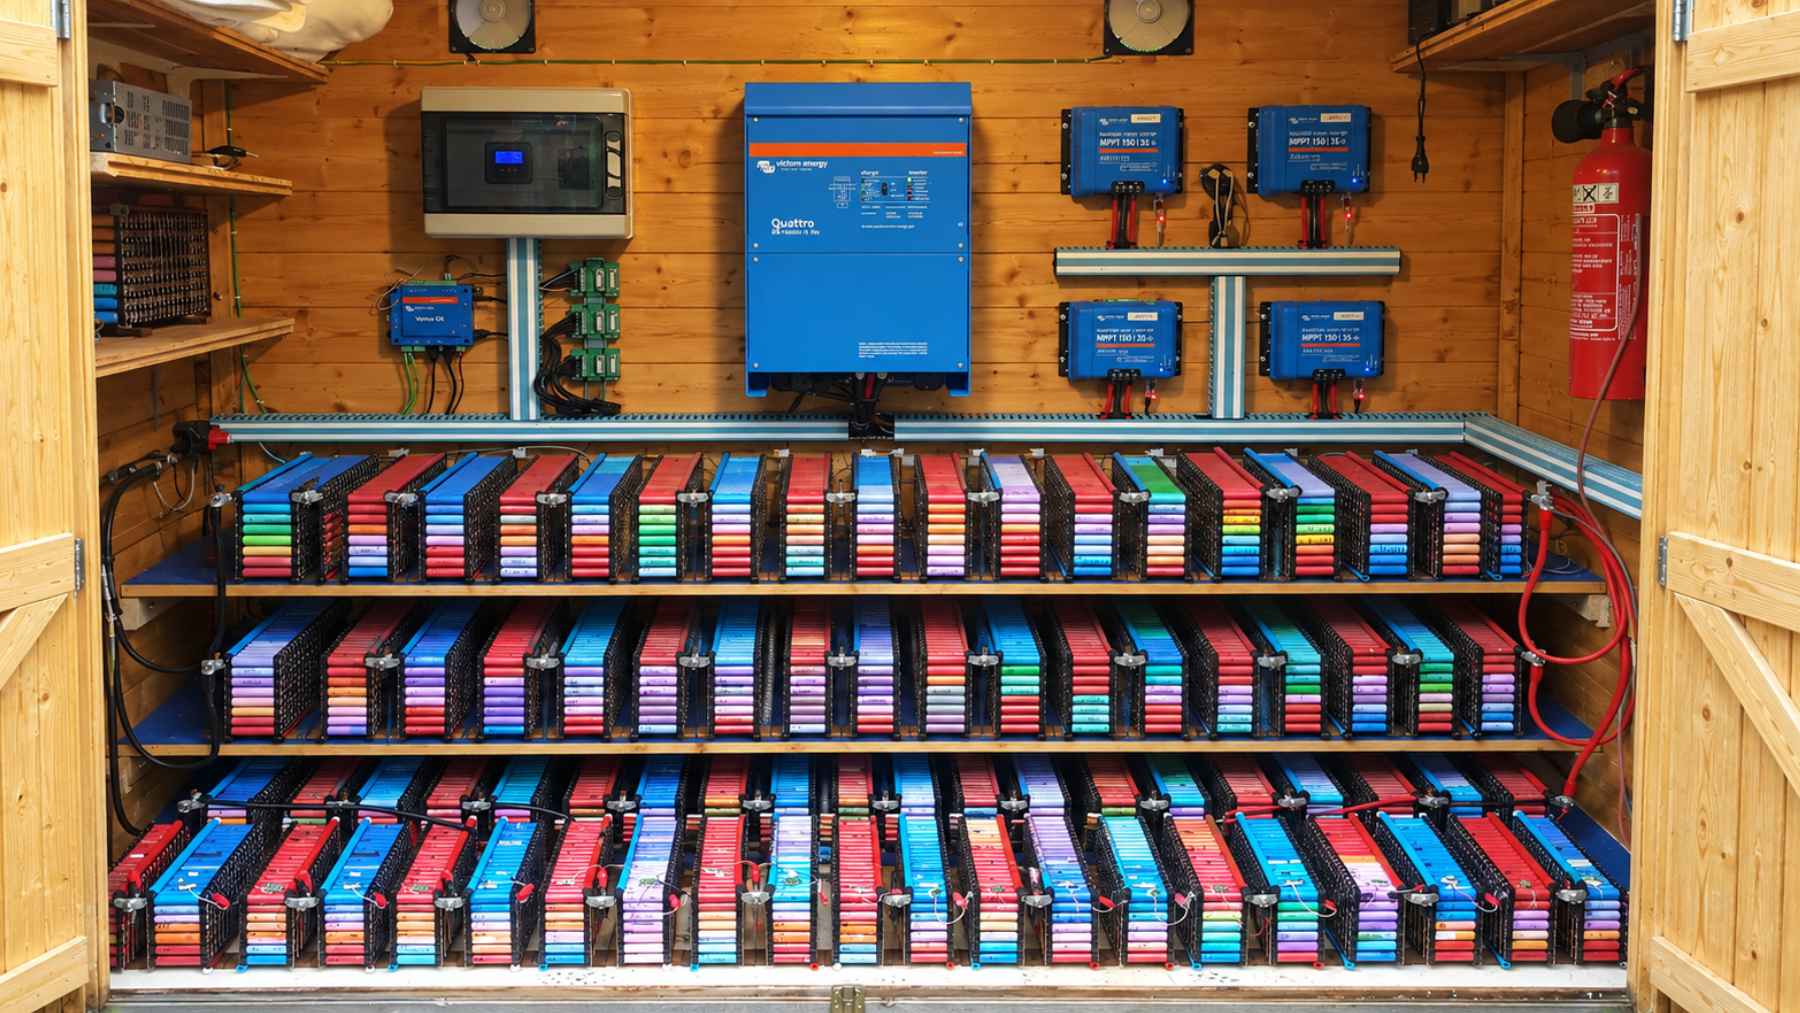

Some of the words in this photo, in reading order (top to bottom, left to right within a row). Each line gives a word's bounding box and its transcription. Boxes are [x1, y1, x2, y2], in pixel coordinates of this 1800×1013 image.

[1100, 138, 1120, 146] MPPT
[1288, 137, 1310, 146] MPPT
[771, 218, 815, 229] Quattro
